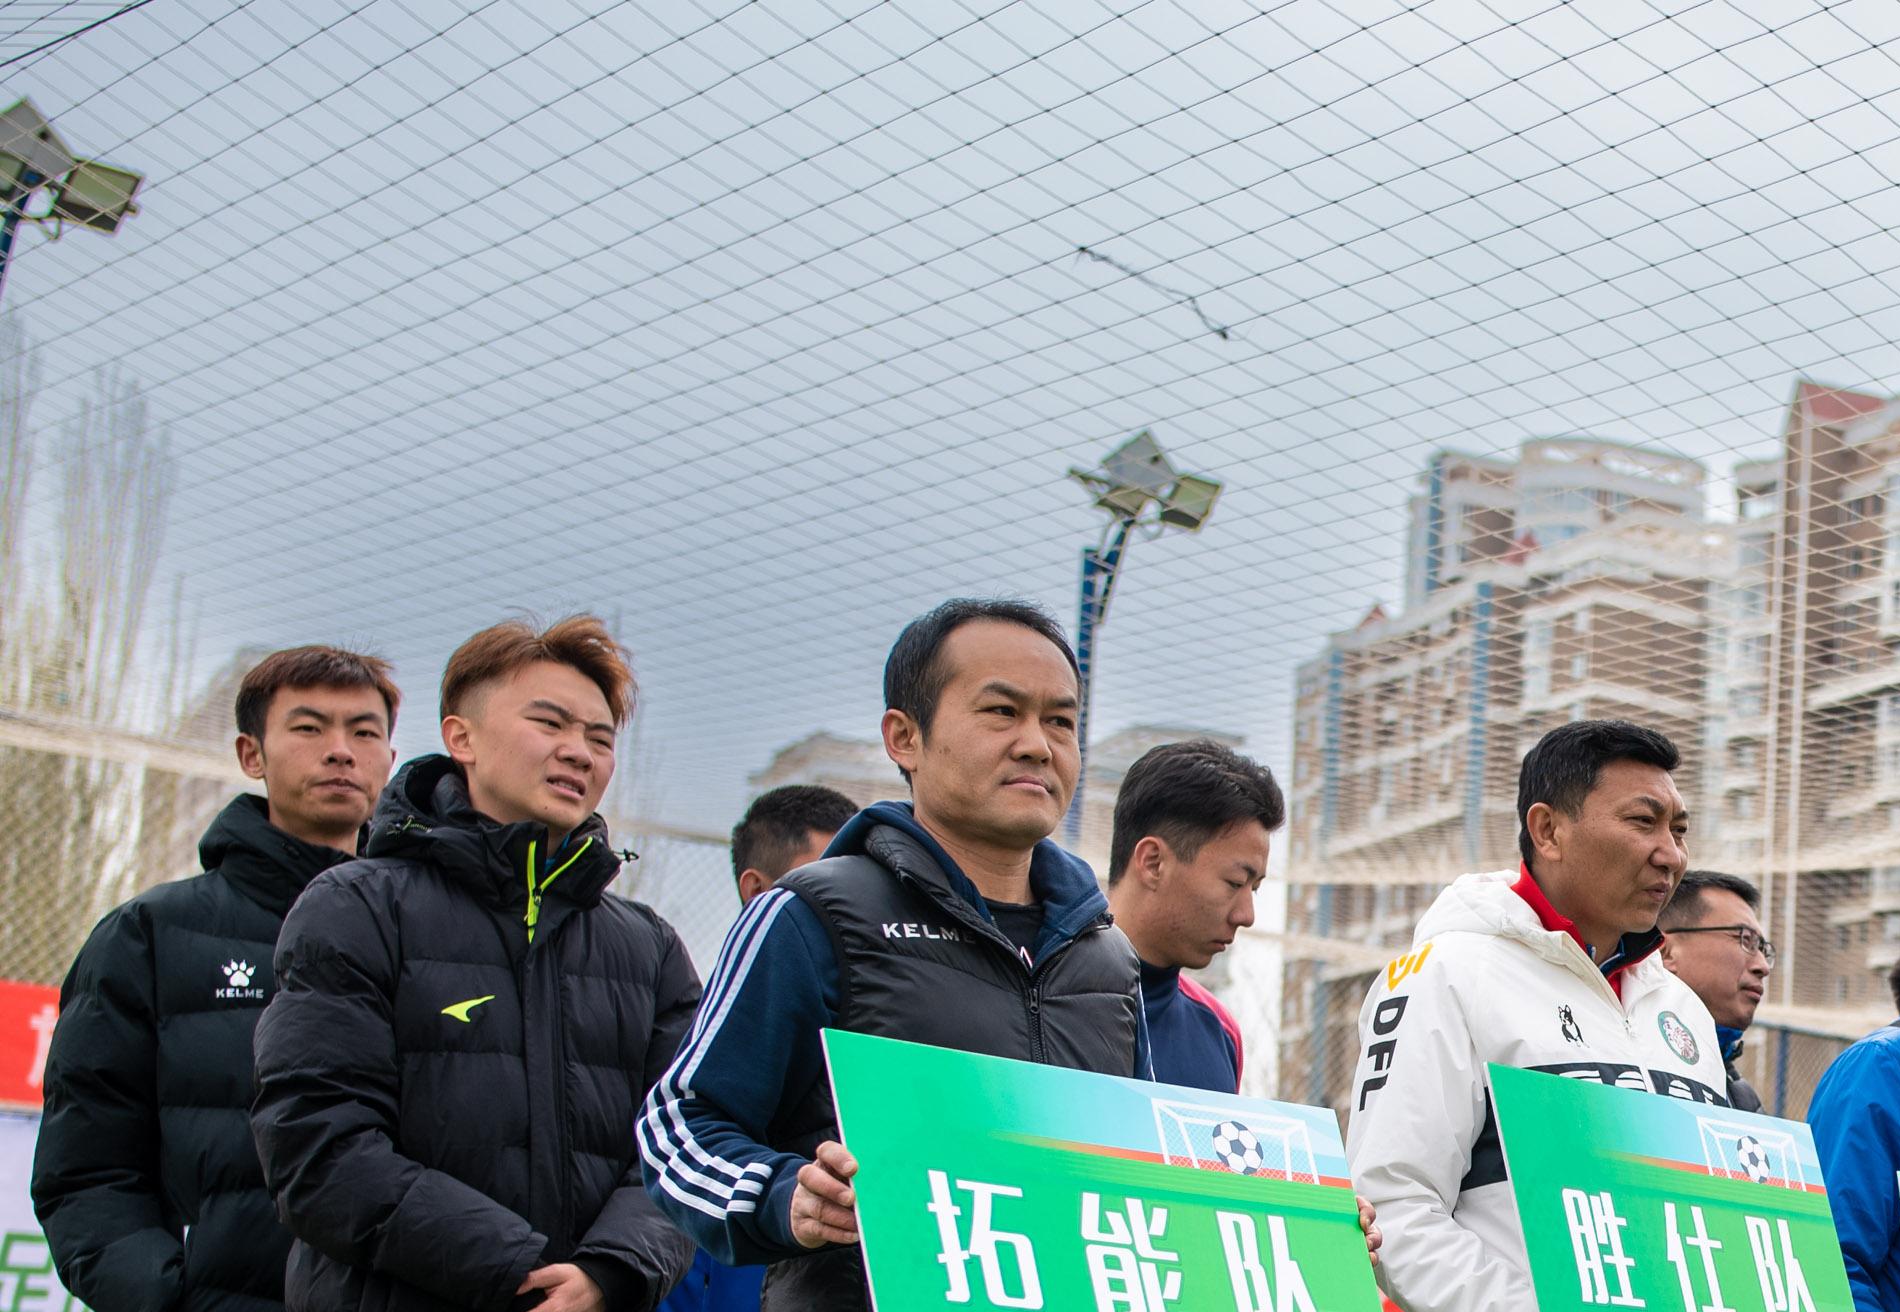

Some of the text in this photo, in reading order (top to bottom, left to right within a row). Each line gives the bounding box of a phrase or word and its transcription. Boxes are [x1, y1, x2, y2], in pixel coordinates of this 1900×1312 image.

[881, 922, 976, 945] KELME
[215, 988, 264, 999] KELME
[1358, 995, 1409, 1112] DFL
